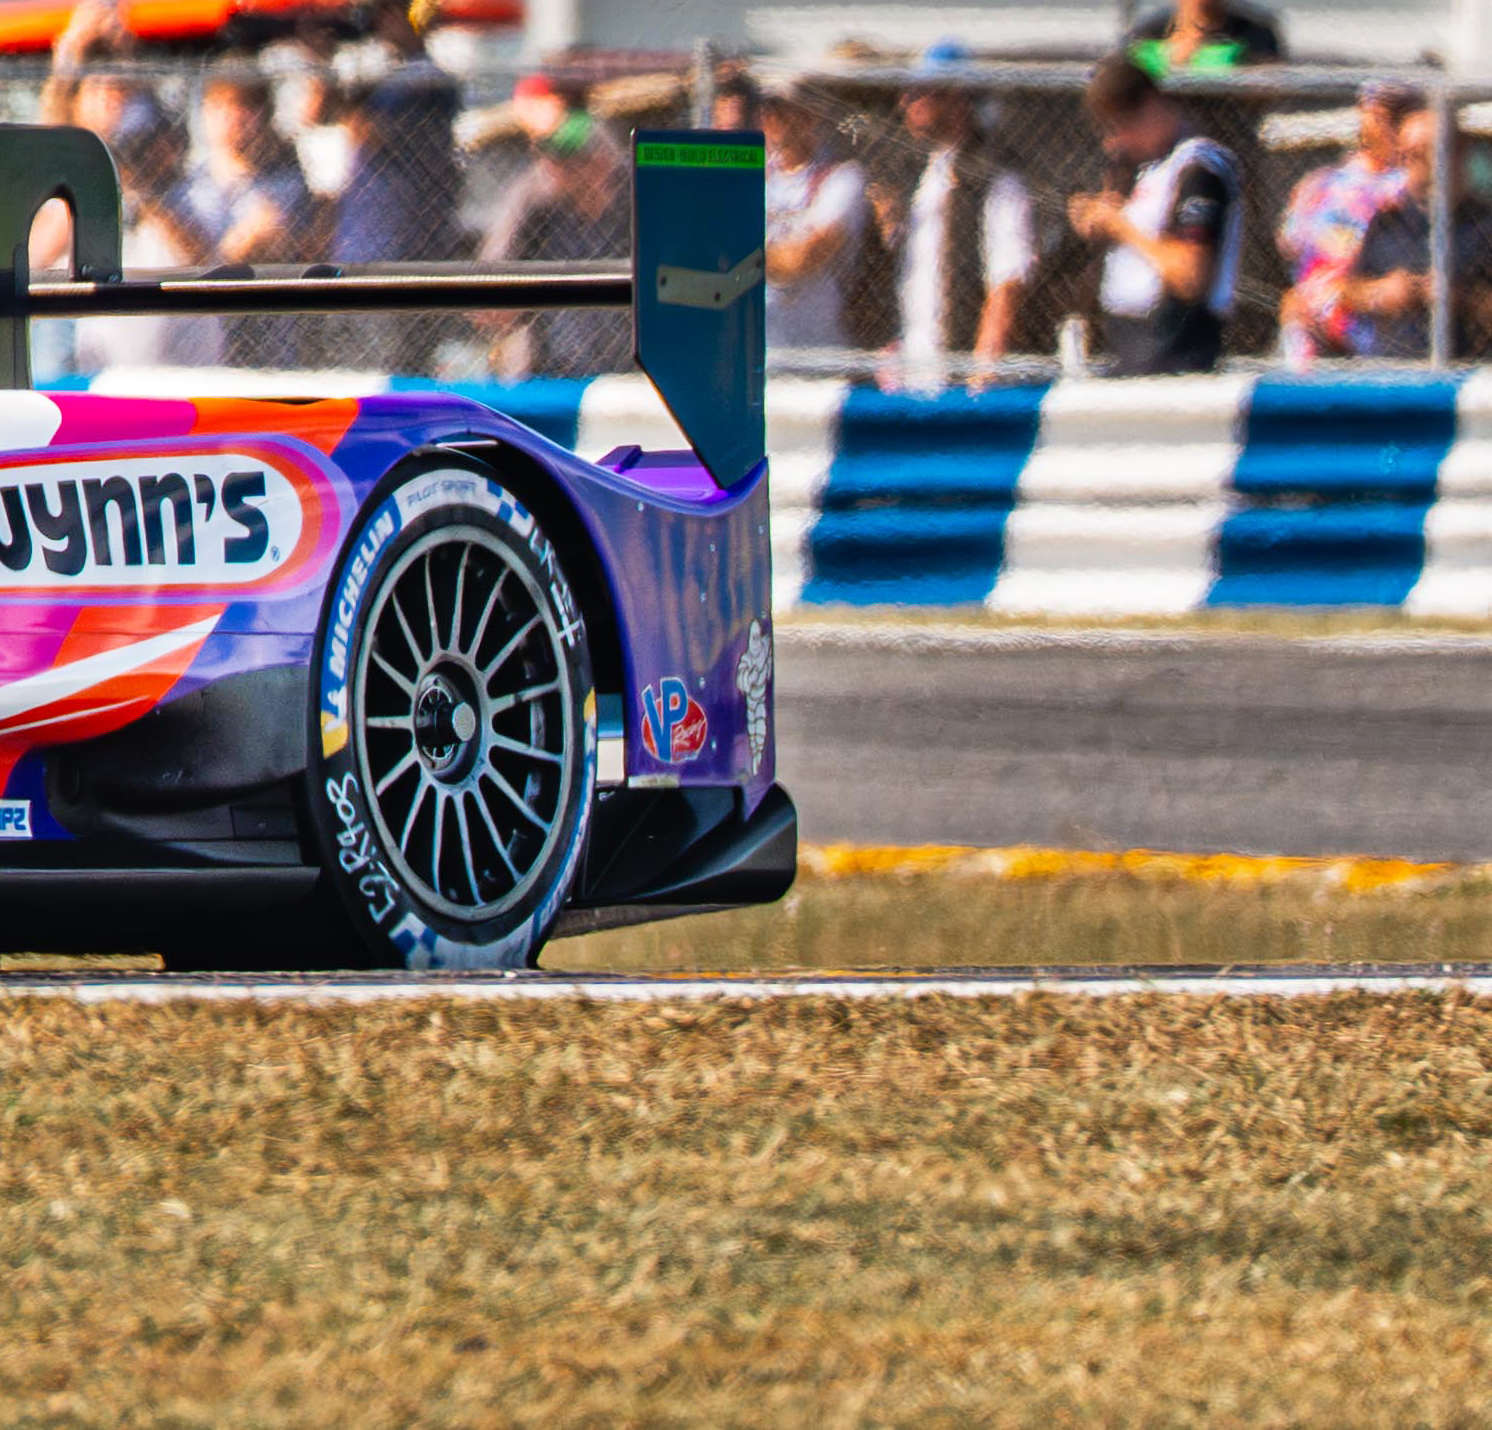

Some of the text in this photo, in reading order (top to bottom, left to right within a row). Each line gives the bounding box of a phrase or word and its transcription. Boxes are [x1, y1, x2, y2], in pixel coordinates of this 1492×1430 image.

[406, 479, 477, 508] PILOT SPORT
[329, 510, 395, 681] MICHELIN
